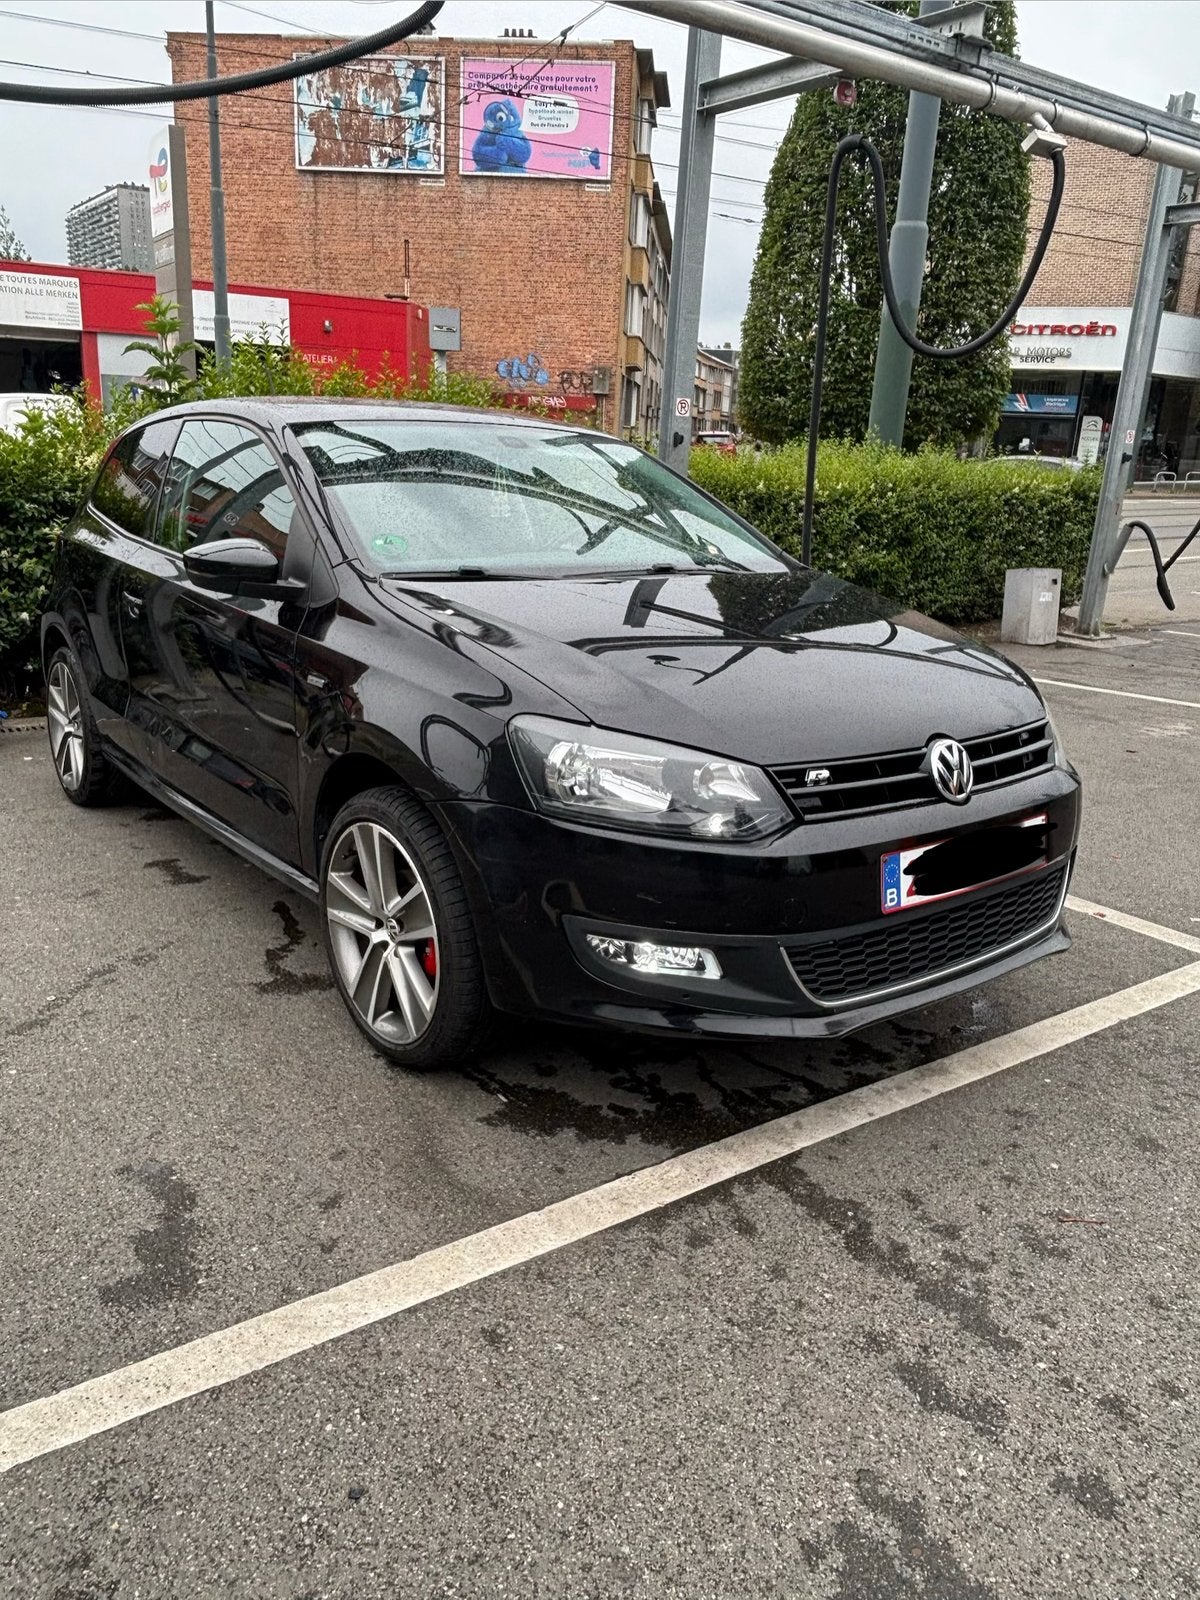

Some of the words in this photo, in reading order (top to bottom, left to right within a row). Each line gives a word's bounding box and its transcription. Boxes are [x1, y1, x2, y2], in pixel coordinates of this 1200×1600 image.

[555, 75, 574, 83] pour
[575, 75, 596, 83] votre
[6, 274, 37, 285] TOUTES
[39, 277, 78, 289] MARQUES
[25, 287, 44, 297] ALLE
[46, 289, 78, 299] MERKEN
[1027, 346, 1072, 358] MOTORS
[302, 353, 334, 364] ATELIER
[1020, 355, 1056, 364] SERVICE
[886, 887, 898, 906] B
